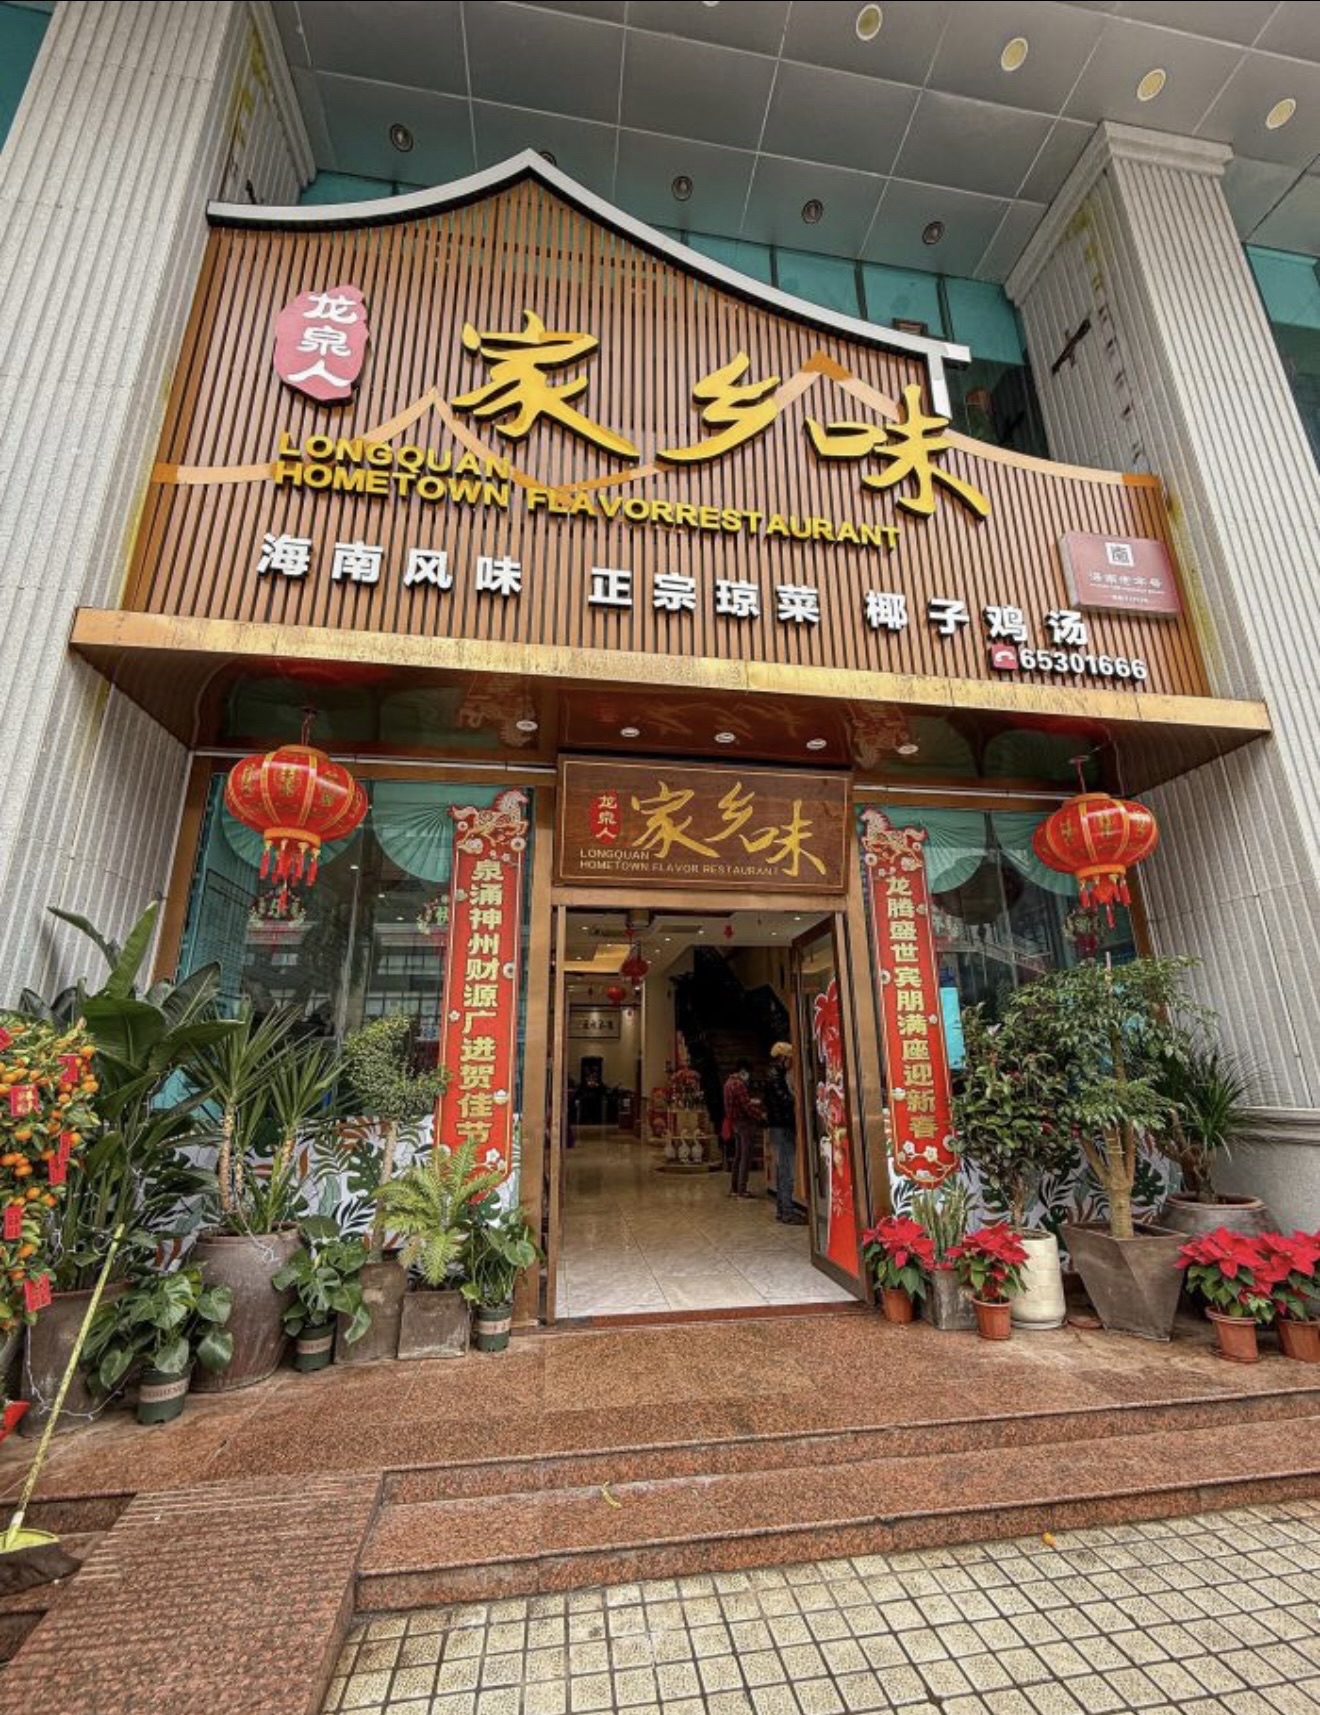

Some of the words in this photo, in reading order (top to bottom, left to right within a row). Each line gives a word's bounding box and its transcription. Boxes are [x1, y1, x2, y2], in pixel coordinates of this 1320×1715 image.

[287, 291, 358, 387] 龙泉人
[452, 309, 993, 519] 家乡味
[273, 461, 511, 508] HOMETOWN
[278, 431, 512, 480] LONGQUAN
[257, 532, 522, 597] 海南风味
[588, 566, 821, 625] 正宗琼菜
[864, 589, 1090, 647] 椰子鸡汤
[1017, 645, 1148, 682] 65301666
[595, 795, 618, 839] 龙泉人
[631, 780, 827, 877] 家乡味
[580, 848, 650, 861] LONGQUAN
[580, 860, 650, 872] HOMETOWN
[652, 863, 699, 874] FLAVOR
[703, 864, 780, 877] RESTAURANT
[456, 859, 504, 1144] 泉涌神州财源广进贺佳节
[885, 876, 939, 1140] 龙腾盛世宾朋满座迎新春
